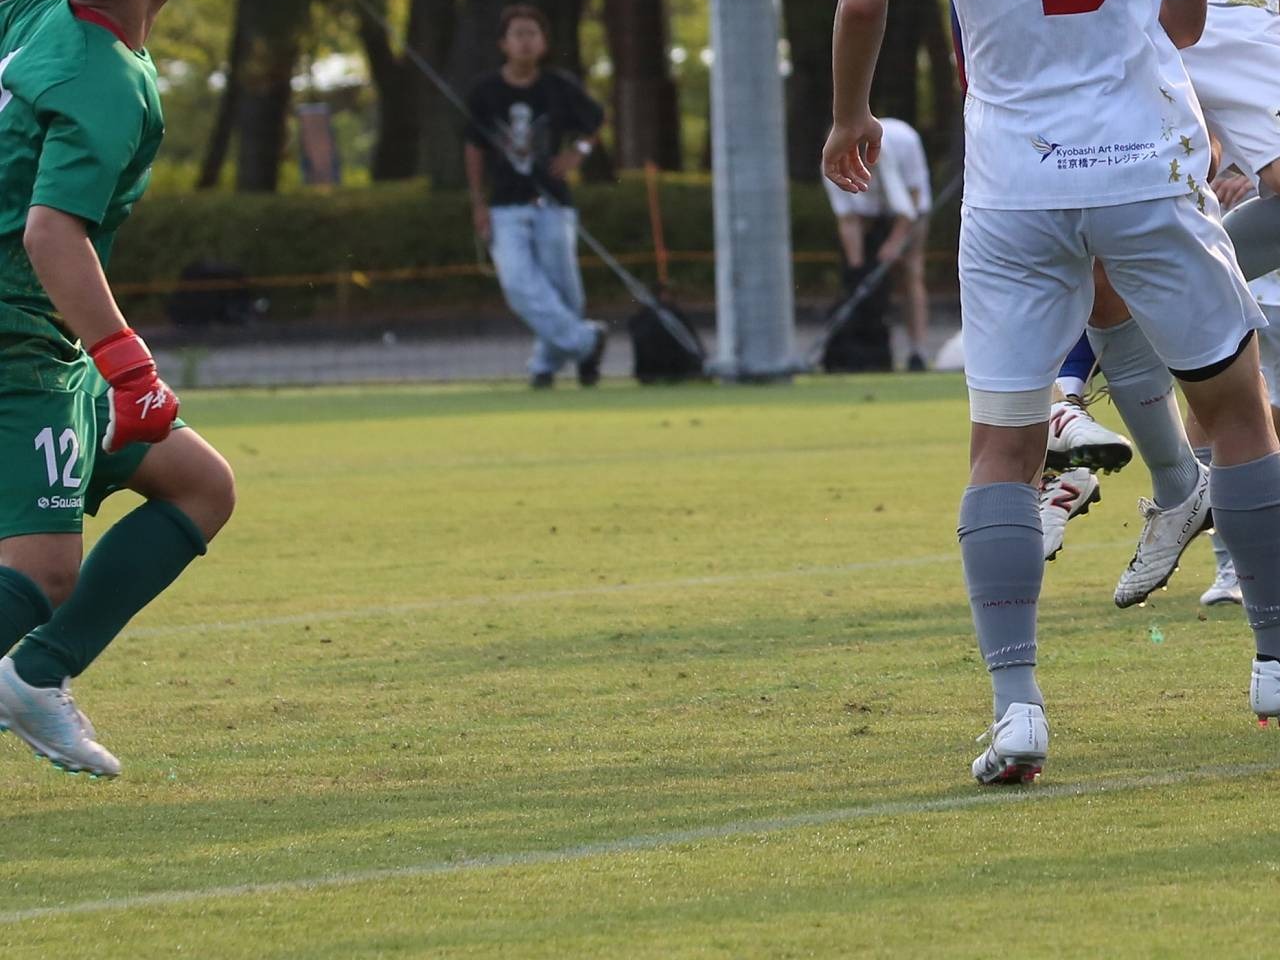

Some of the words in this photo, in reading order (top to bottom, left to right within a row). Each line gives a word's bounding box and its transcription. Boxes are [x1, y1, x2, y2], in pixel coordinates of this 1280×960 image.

[1056, 146, 1096, 158] Kyobashi
[1098, 145, 1112, 153] Art
[1113, 141, 1156, 152] Residence
[34, 426, 82, 489] 12
